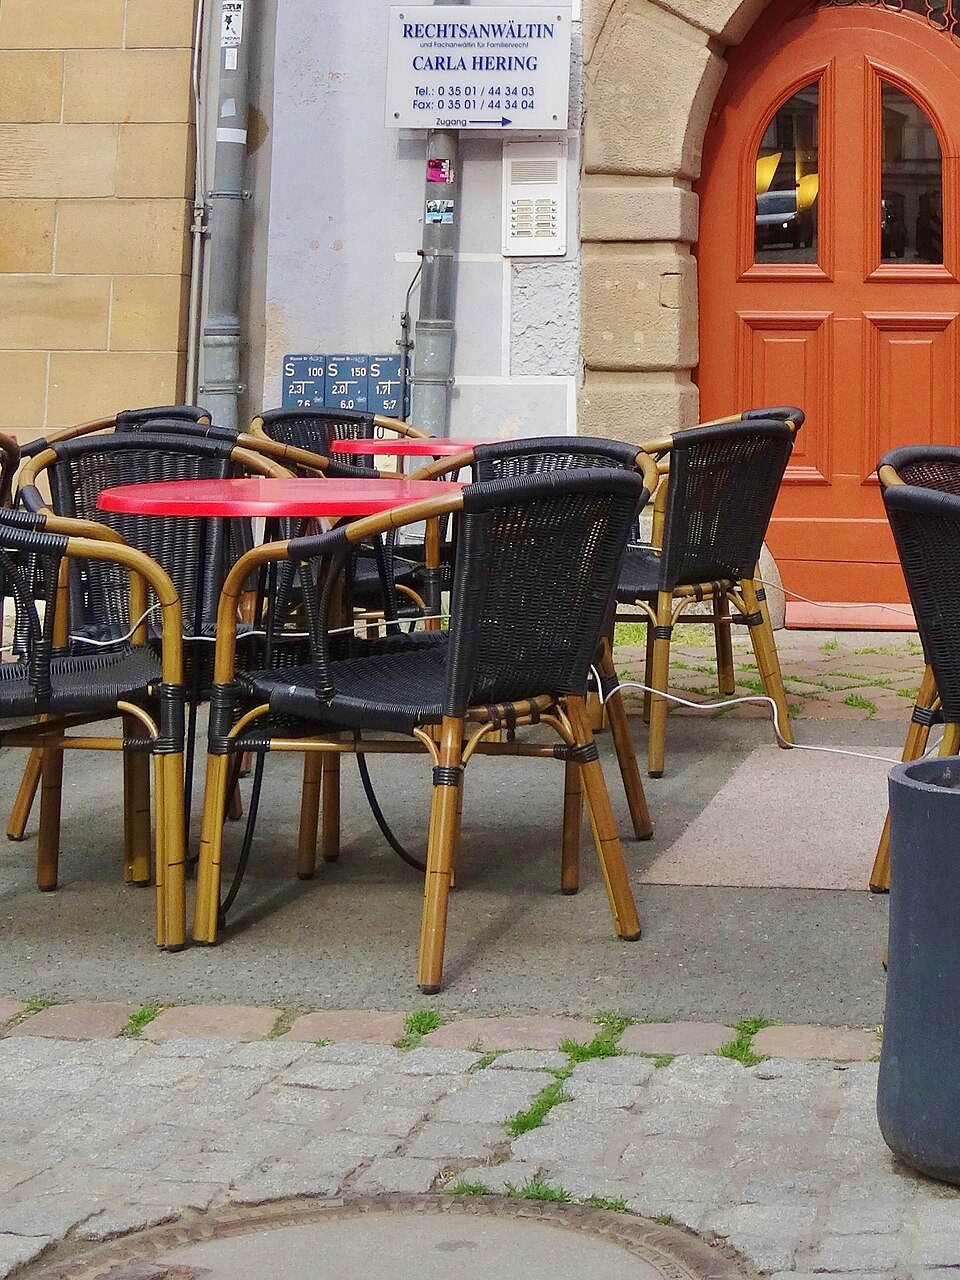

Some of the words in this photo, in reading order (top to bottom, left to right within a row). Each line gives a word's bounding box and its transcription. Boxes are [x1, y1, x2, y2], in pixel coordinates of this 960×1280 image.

[402, 19, 555, 39] RECHTSANWÄLTIN
[412, 55, 467, 71] CARLA
[471, 55, 539, 71] HERING
[415, 86, 434, 96] Tel.:
[438, 86, 445, 96] 0
[448, 86, 461, 96] 35
[464, 86, 477, 96] 01
[488, 86, 501, 96] 44
[505, 86, 518, 96] 34
[521, 86, 535, 96] 03
[412, 99, 434, 110] Fax:
[437, 99, 444, 110] 0
[447, 99, 461, 110] 35
[464, 99, 476, 110] 01
[488, 99, 501, 110] 44
[504, 99, 518, 110] 34
[521, 99, 535, 110] 04
[436, 118, 467, 127] Zugang
[285, 363, 295, 377] S
[307, 367, 324, 377] 100
[328, 363, 338, 377] S
[350, 367, 366, 377] 150
[370, 363, 380, 377] S
